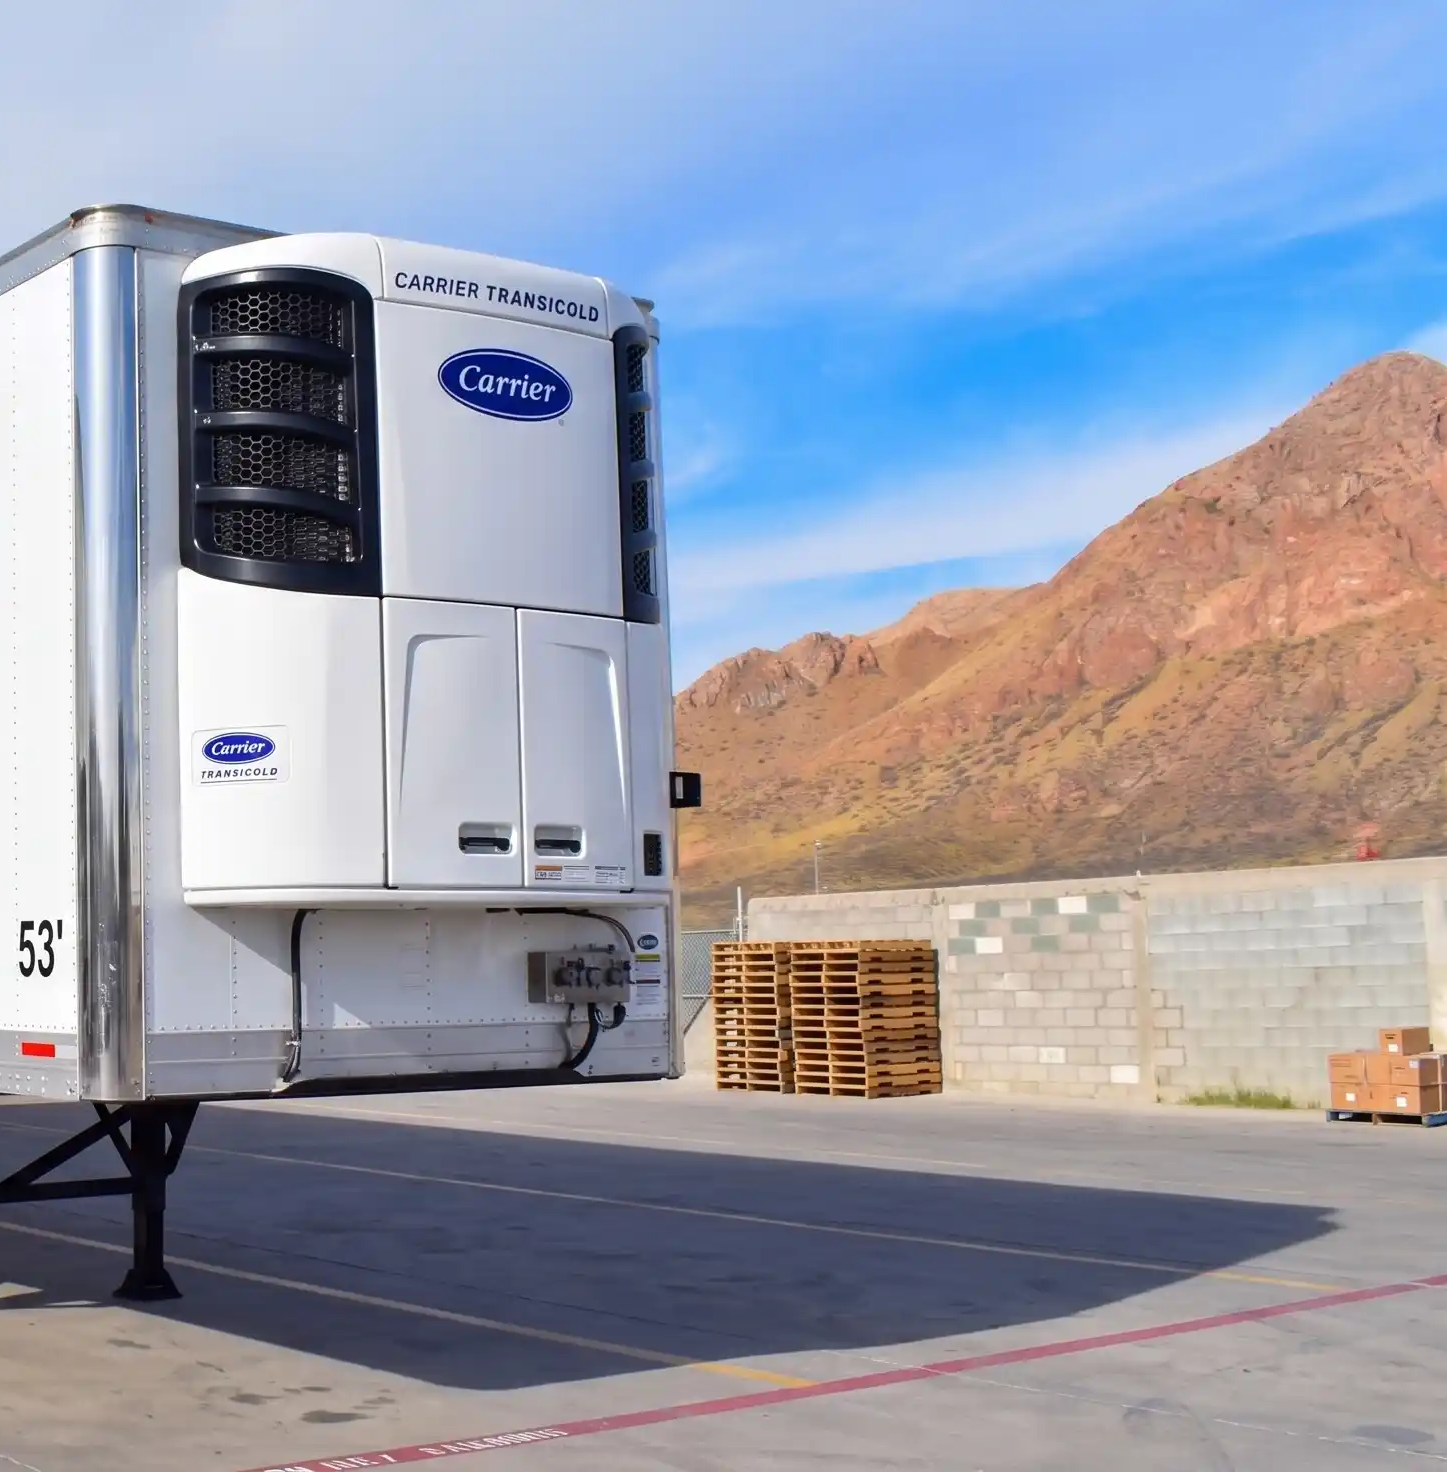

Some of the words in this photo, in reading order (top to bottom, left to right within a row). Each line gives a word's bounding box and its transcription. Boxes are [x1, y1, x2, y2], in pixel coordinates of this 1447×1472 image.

[394, 271, 479, 299] CARRIER
[486, 285, 599, 322] TRANSICOLD
[458, 365, 556, 403] Carrier
[211, 740, 266, 756] Carrier
[201, 767, 278, 779] TRANSICOLD
[19, 919, 63, 977] 53'
